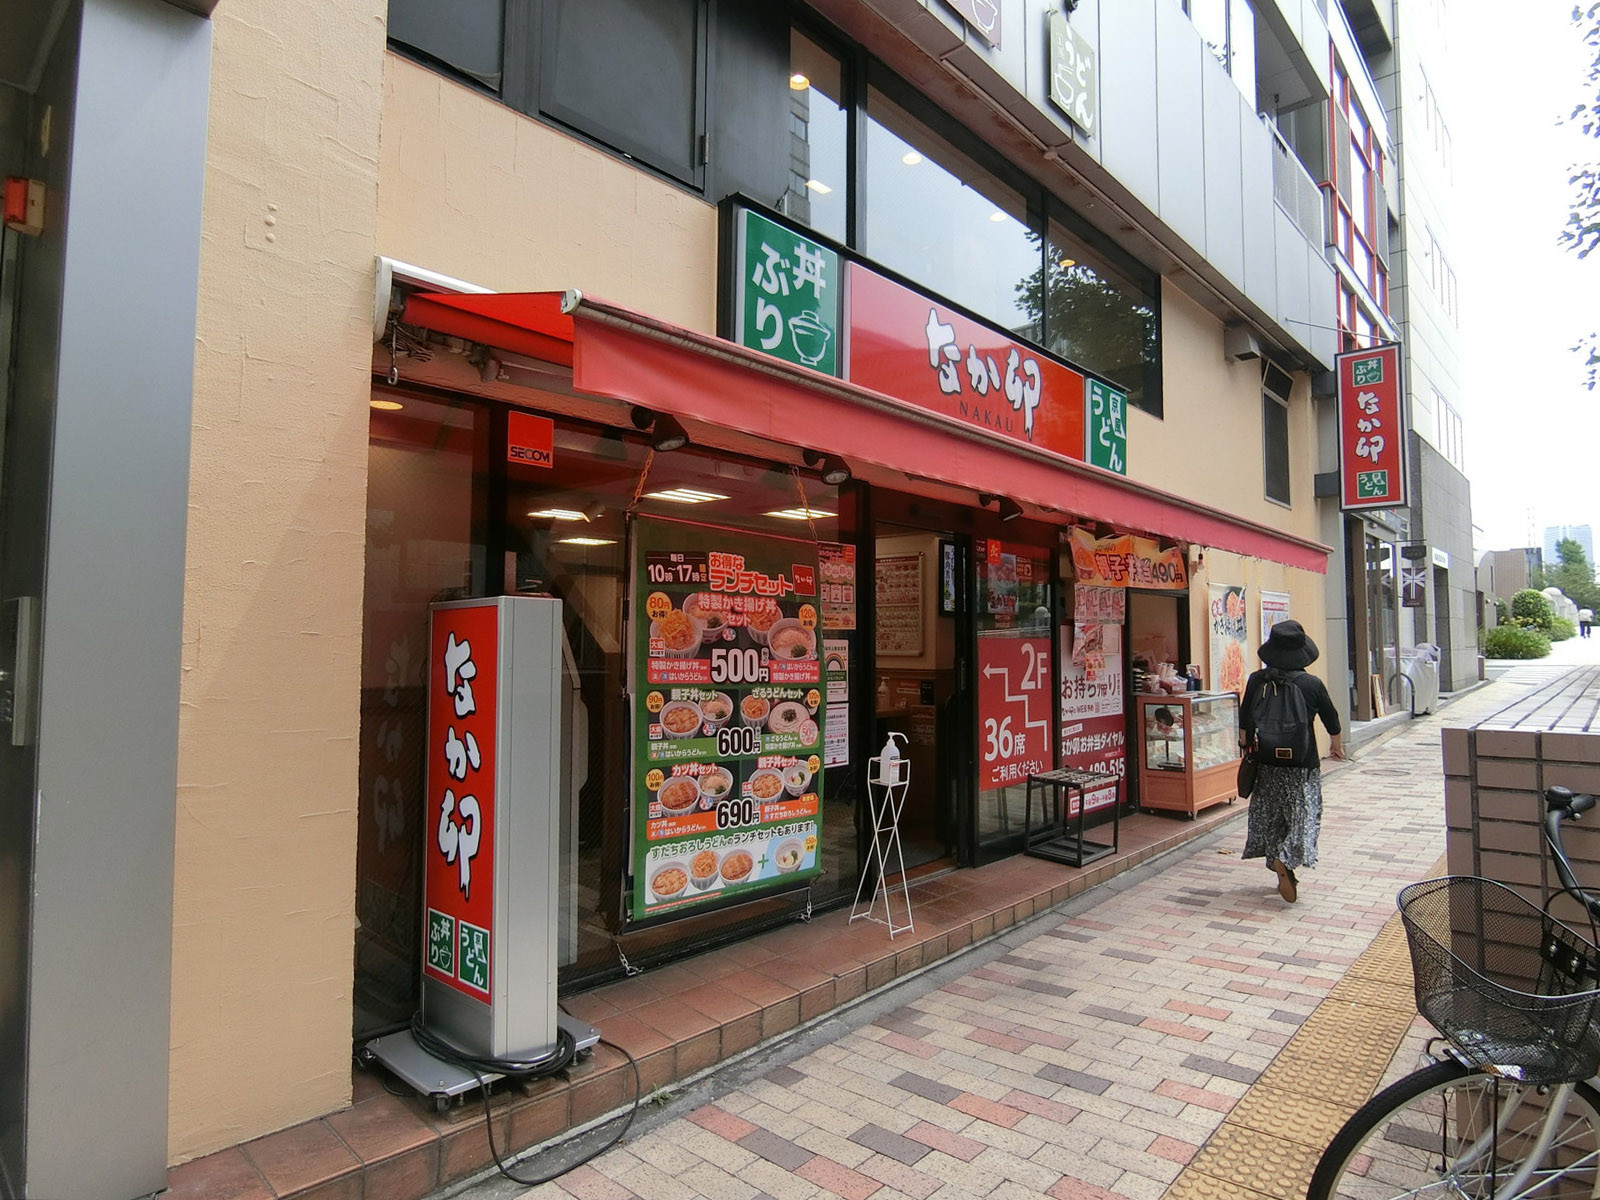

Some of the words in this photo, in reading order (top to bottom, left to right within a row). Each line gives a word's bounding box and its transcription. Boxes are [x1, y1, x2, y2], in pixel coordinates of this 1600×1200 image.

[925, 307, 1042, 442] なか卯
[958, 399, 1014, 434] NAKAU
[1092, 385, 1122, 472] うどん
[1355, 391, 1385, 465] なか卯
[510, 446, 550, 463] SECOM
[670, 553, 685, 562] 毎日
[709, 552, 745, 570] お得な
[710, 569, 794, 597] ランチセット
[649, 597, 670, 609] 80円
[727, 614, 751, 626] セット
[651, 660, 700, 670] 特製かき揚げ丼
[668, 672, 702, 681] はいからうどん
[1021, 642, 1048, 690] 2F
[671, 688, 718, 701] 親子丼セット
[752, 687, 804, 699] ざるうどんセット
[1061, 673, 1117, 700] お持ち帰り
[717, 727, 761, 755] 600円
[984, 715, 1026, 762] 36席
[438, 631, 481, 899] なか卯
[671, 762, 719, 777] カツ丼セット
[992, 759, 1044, 783] ご利用ください
[717, 798, 761, 830] 690円
[650, 821, 815, 860] すだちおろしうどんのランチセットもあります!
[461, 927, 484, 986] うどん
